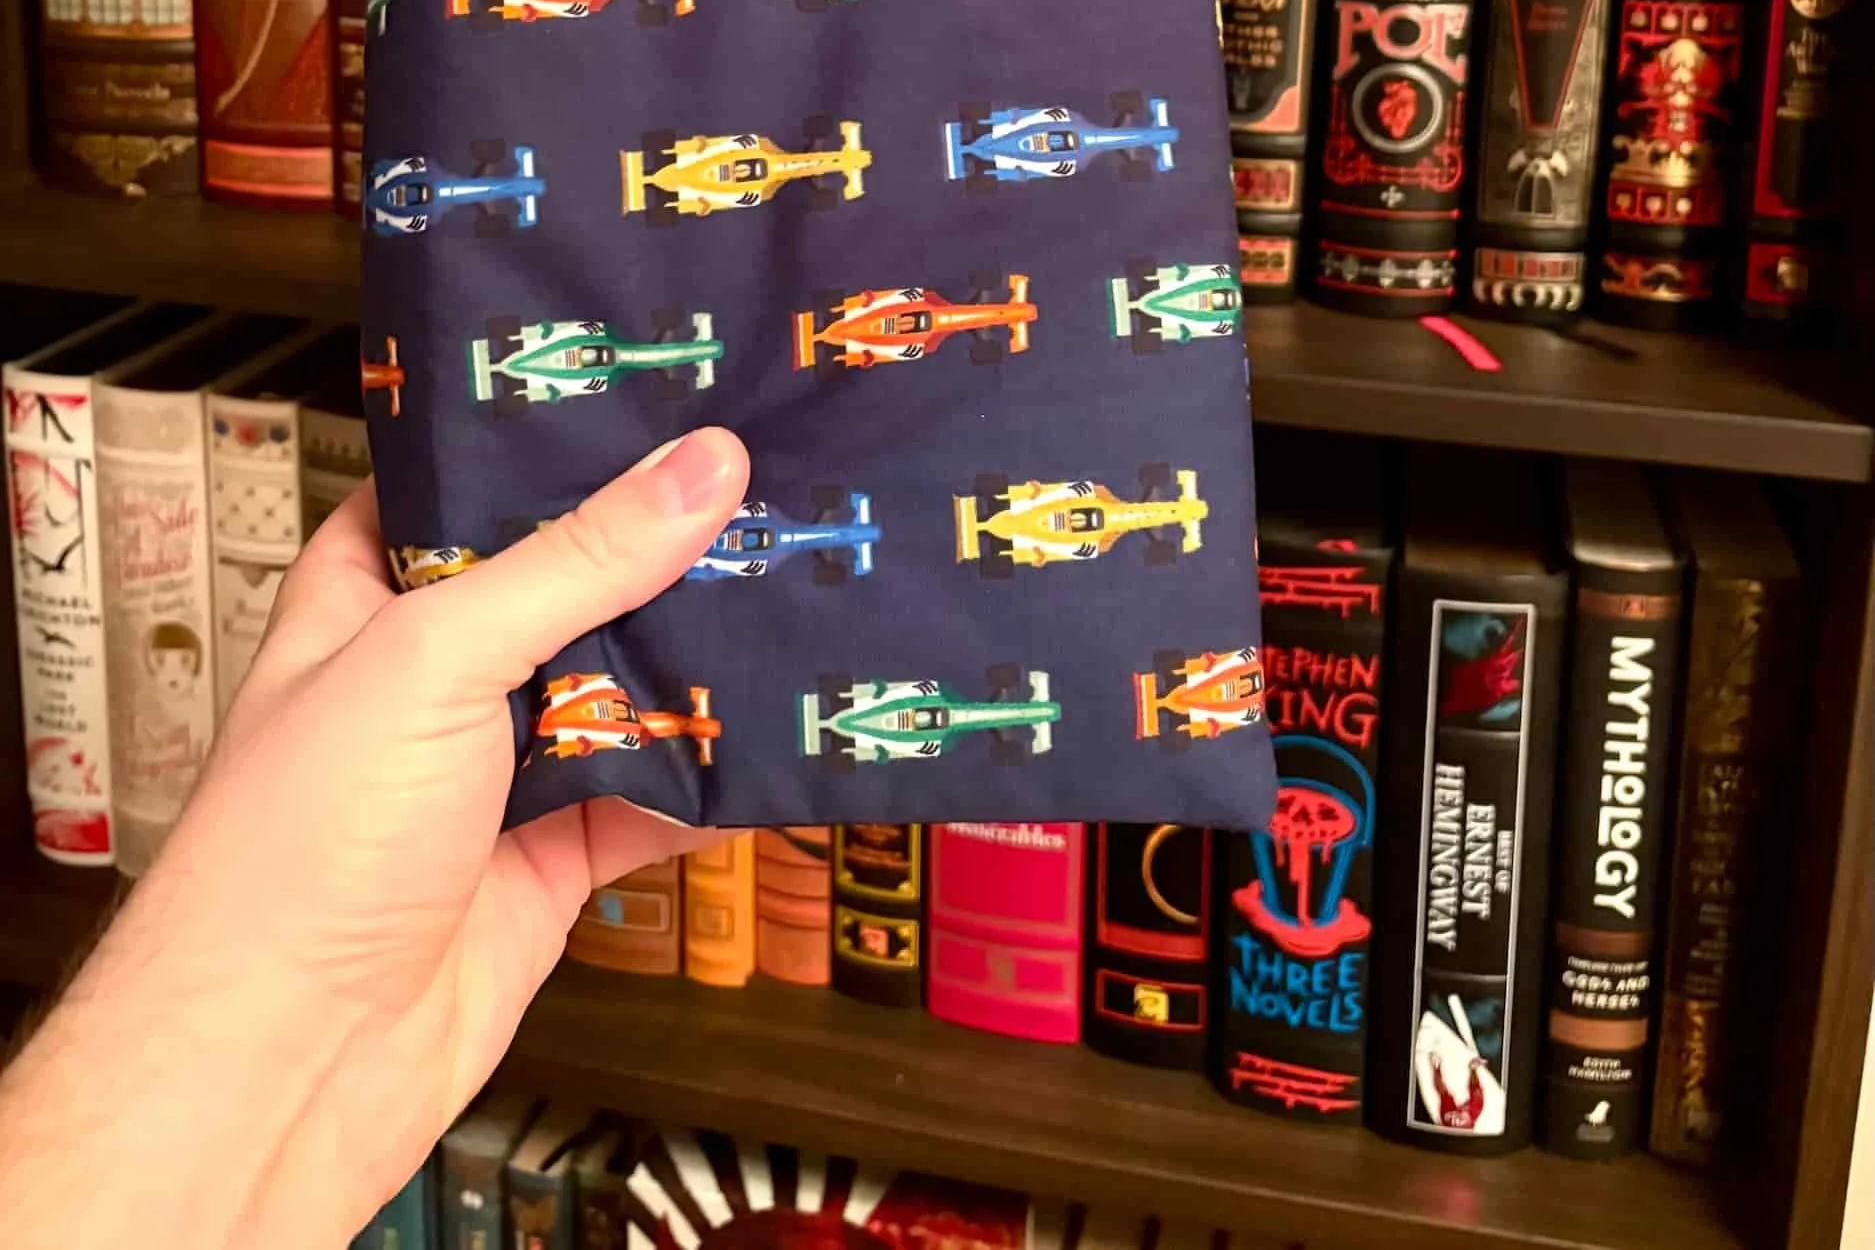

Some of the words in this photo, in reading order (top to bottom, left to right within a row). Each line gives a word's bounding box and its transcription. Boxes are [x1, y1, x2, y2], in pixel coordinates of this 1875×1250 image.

[1336, 1, 1470, 84] POE
[1262, 644, 1379, 690] TEPHEN
[1264, 685, 1379, 748] ING
[1593, 636, 1655, 919] MYTHOLOGY
[1427, 763, 1466, 952] HEMINGWAY
[1462, 802, 1496, 921] ERNEST
[1232, 932, 1366, 996] THREE
[1616, 975, 1650, 992] AND
